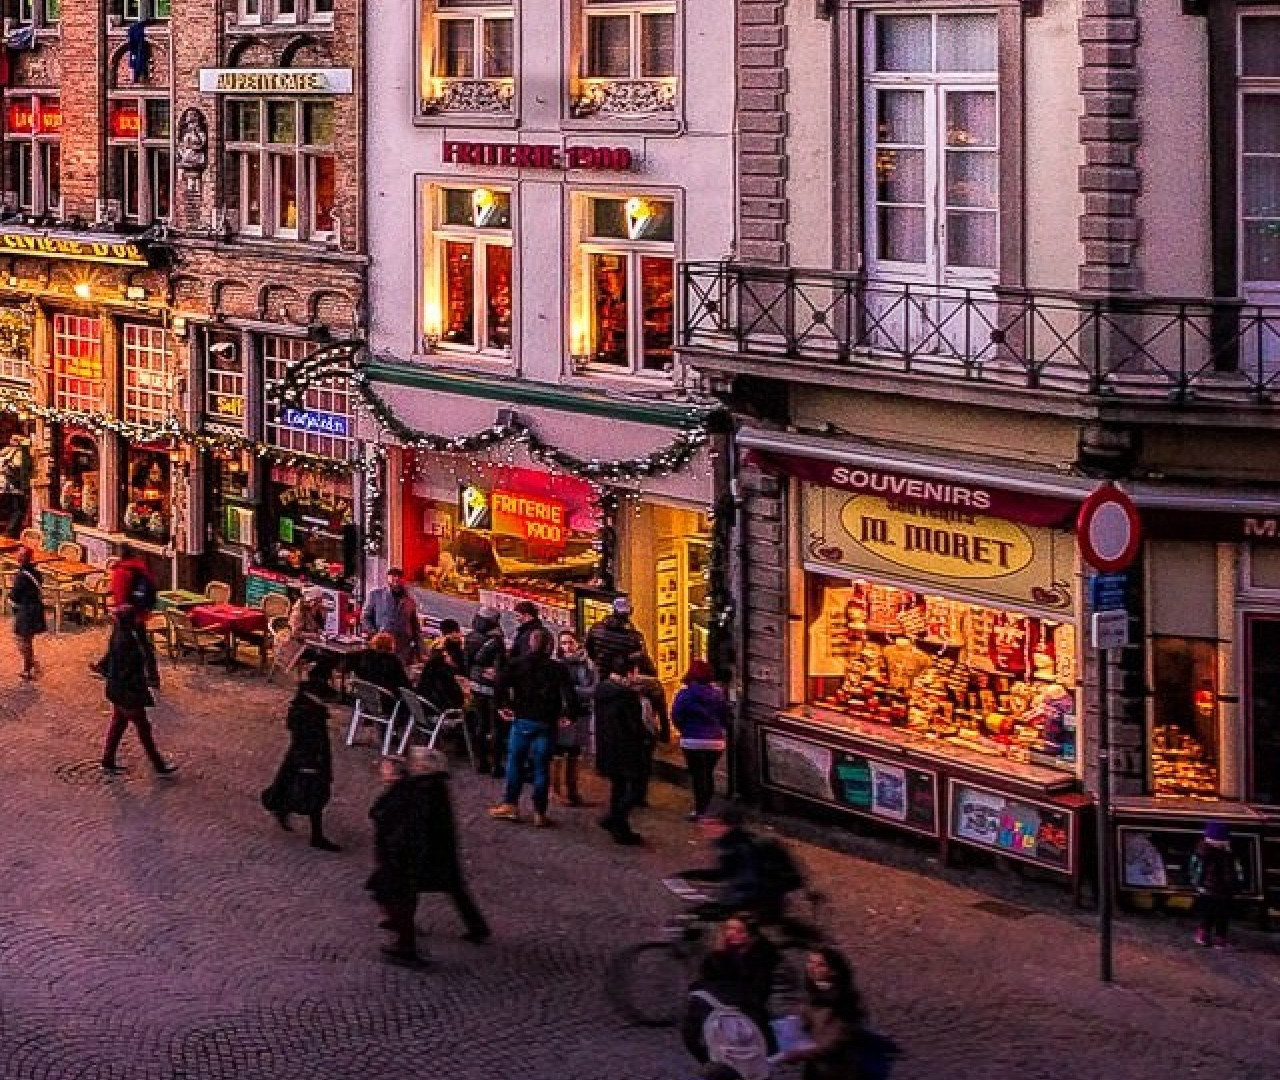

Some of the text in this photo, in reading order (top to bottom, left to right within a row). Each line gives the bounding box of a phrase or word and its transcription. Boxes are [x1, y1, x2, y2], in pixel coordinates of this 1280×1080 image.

[443, 141, 633, 170] FRITERIE 1900
[831, 467, 991, 508] SOUVENIRS
[492, 494, 561, 524] FRITERIE
[527, 521, 561, 542] 1900
[860, 515, 1013, 569] M. MORET
